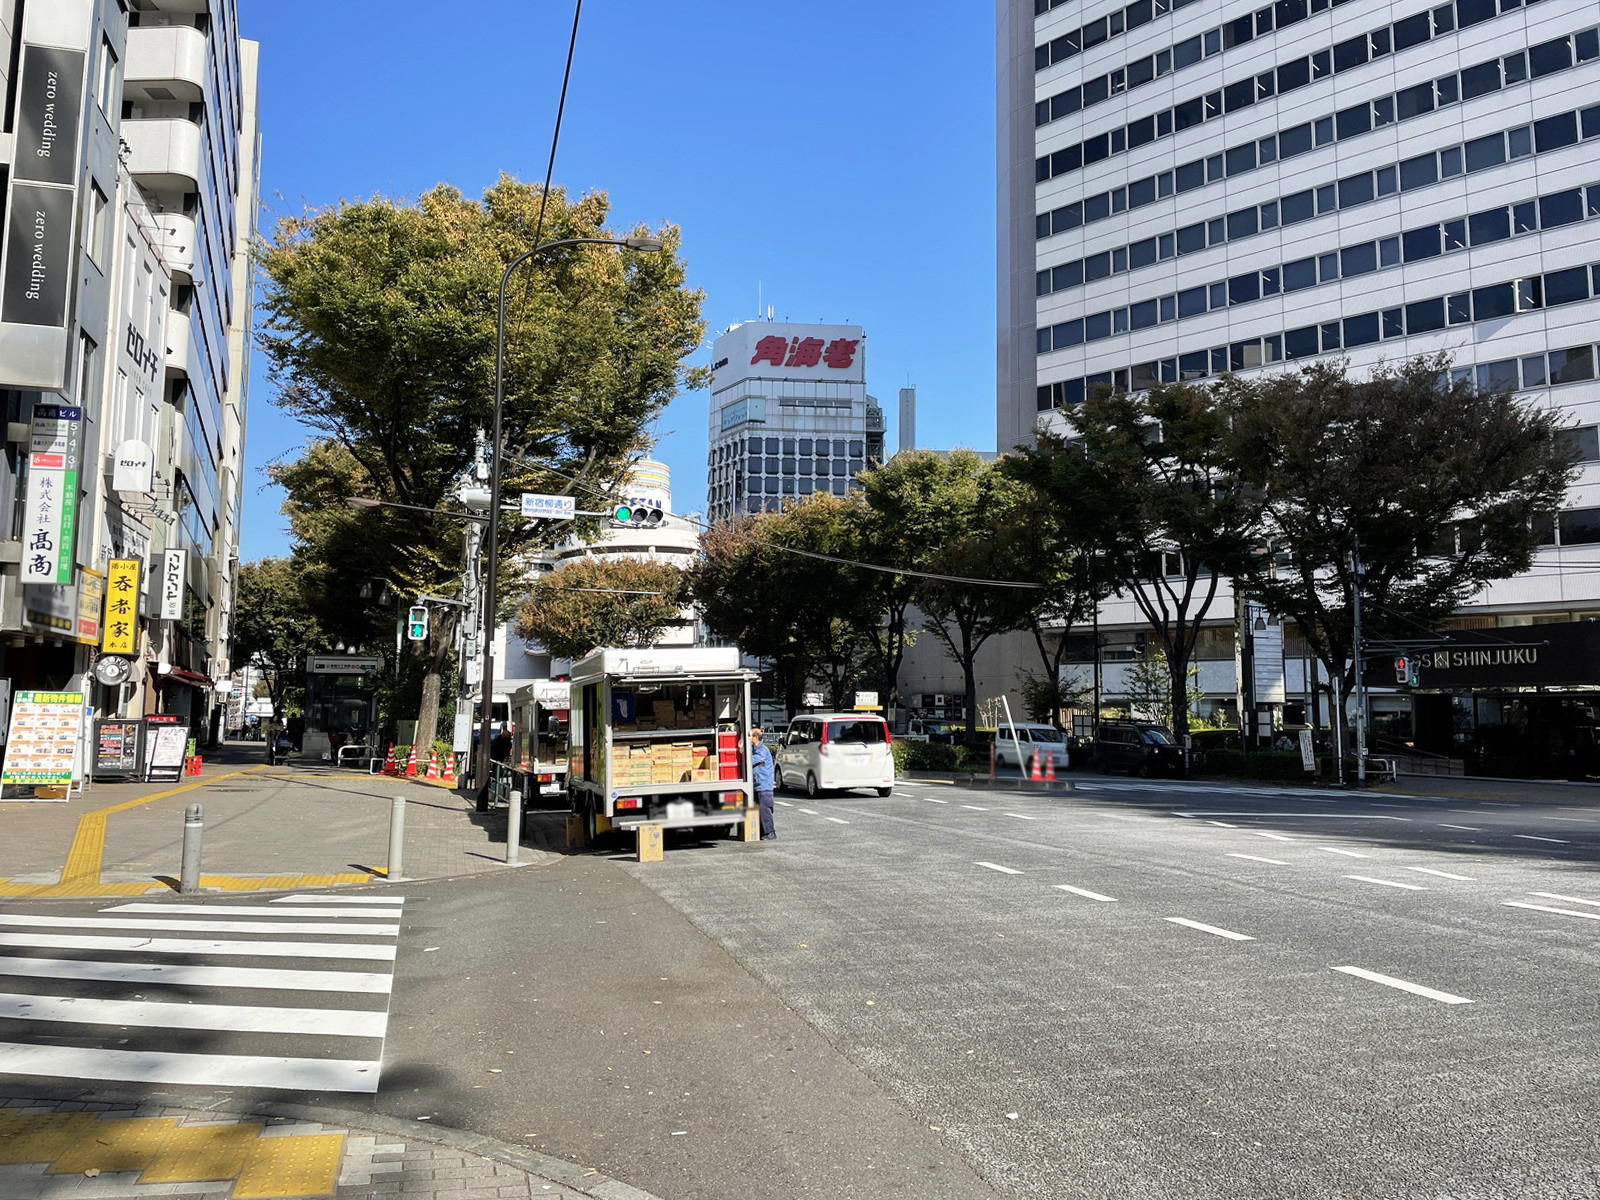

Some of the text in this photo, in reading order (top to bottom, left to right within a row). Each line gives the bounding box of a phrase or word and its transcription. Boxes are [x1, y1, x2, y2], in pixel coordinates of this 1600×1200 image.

[37, 72, 58, 158] zero wedding
[25, 211, 46, 300] zero wedding
[751, 335, 859, 369] 角海老
[525, 497, 573, 510] 新宿柳通り
[166, 554, 180, 601] ヤングマン
[109, 575, 134, 638] 呑者家
[1453, 648, 1538, 667] SHINJUKU
